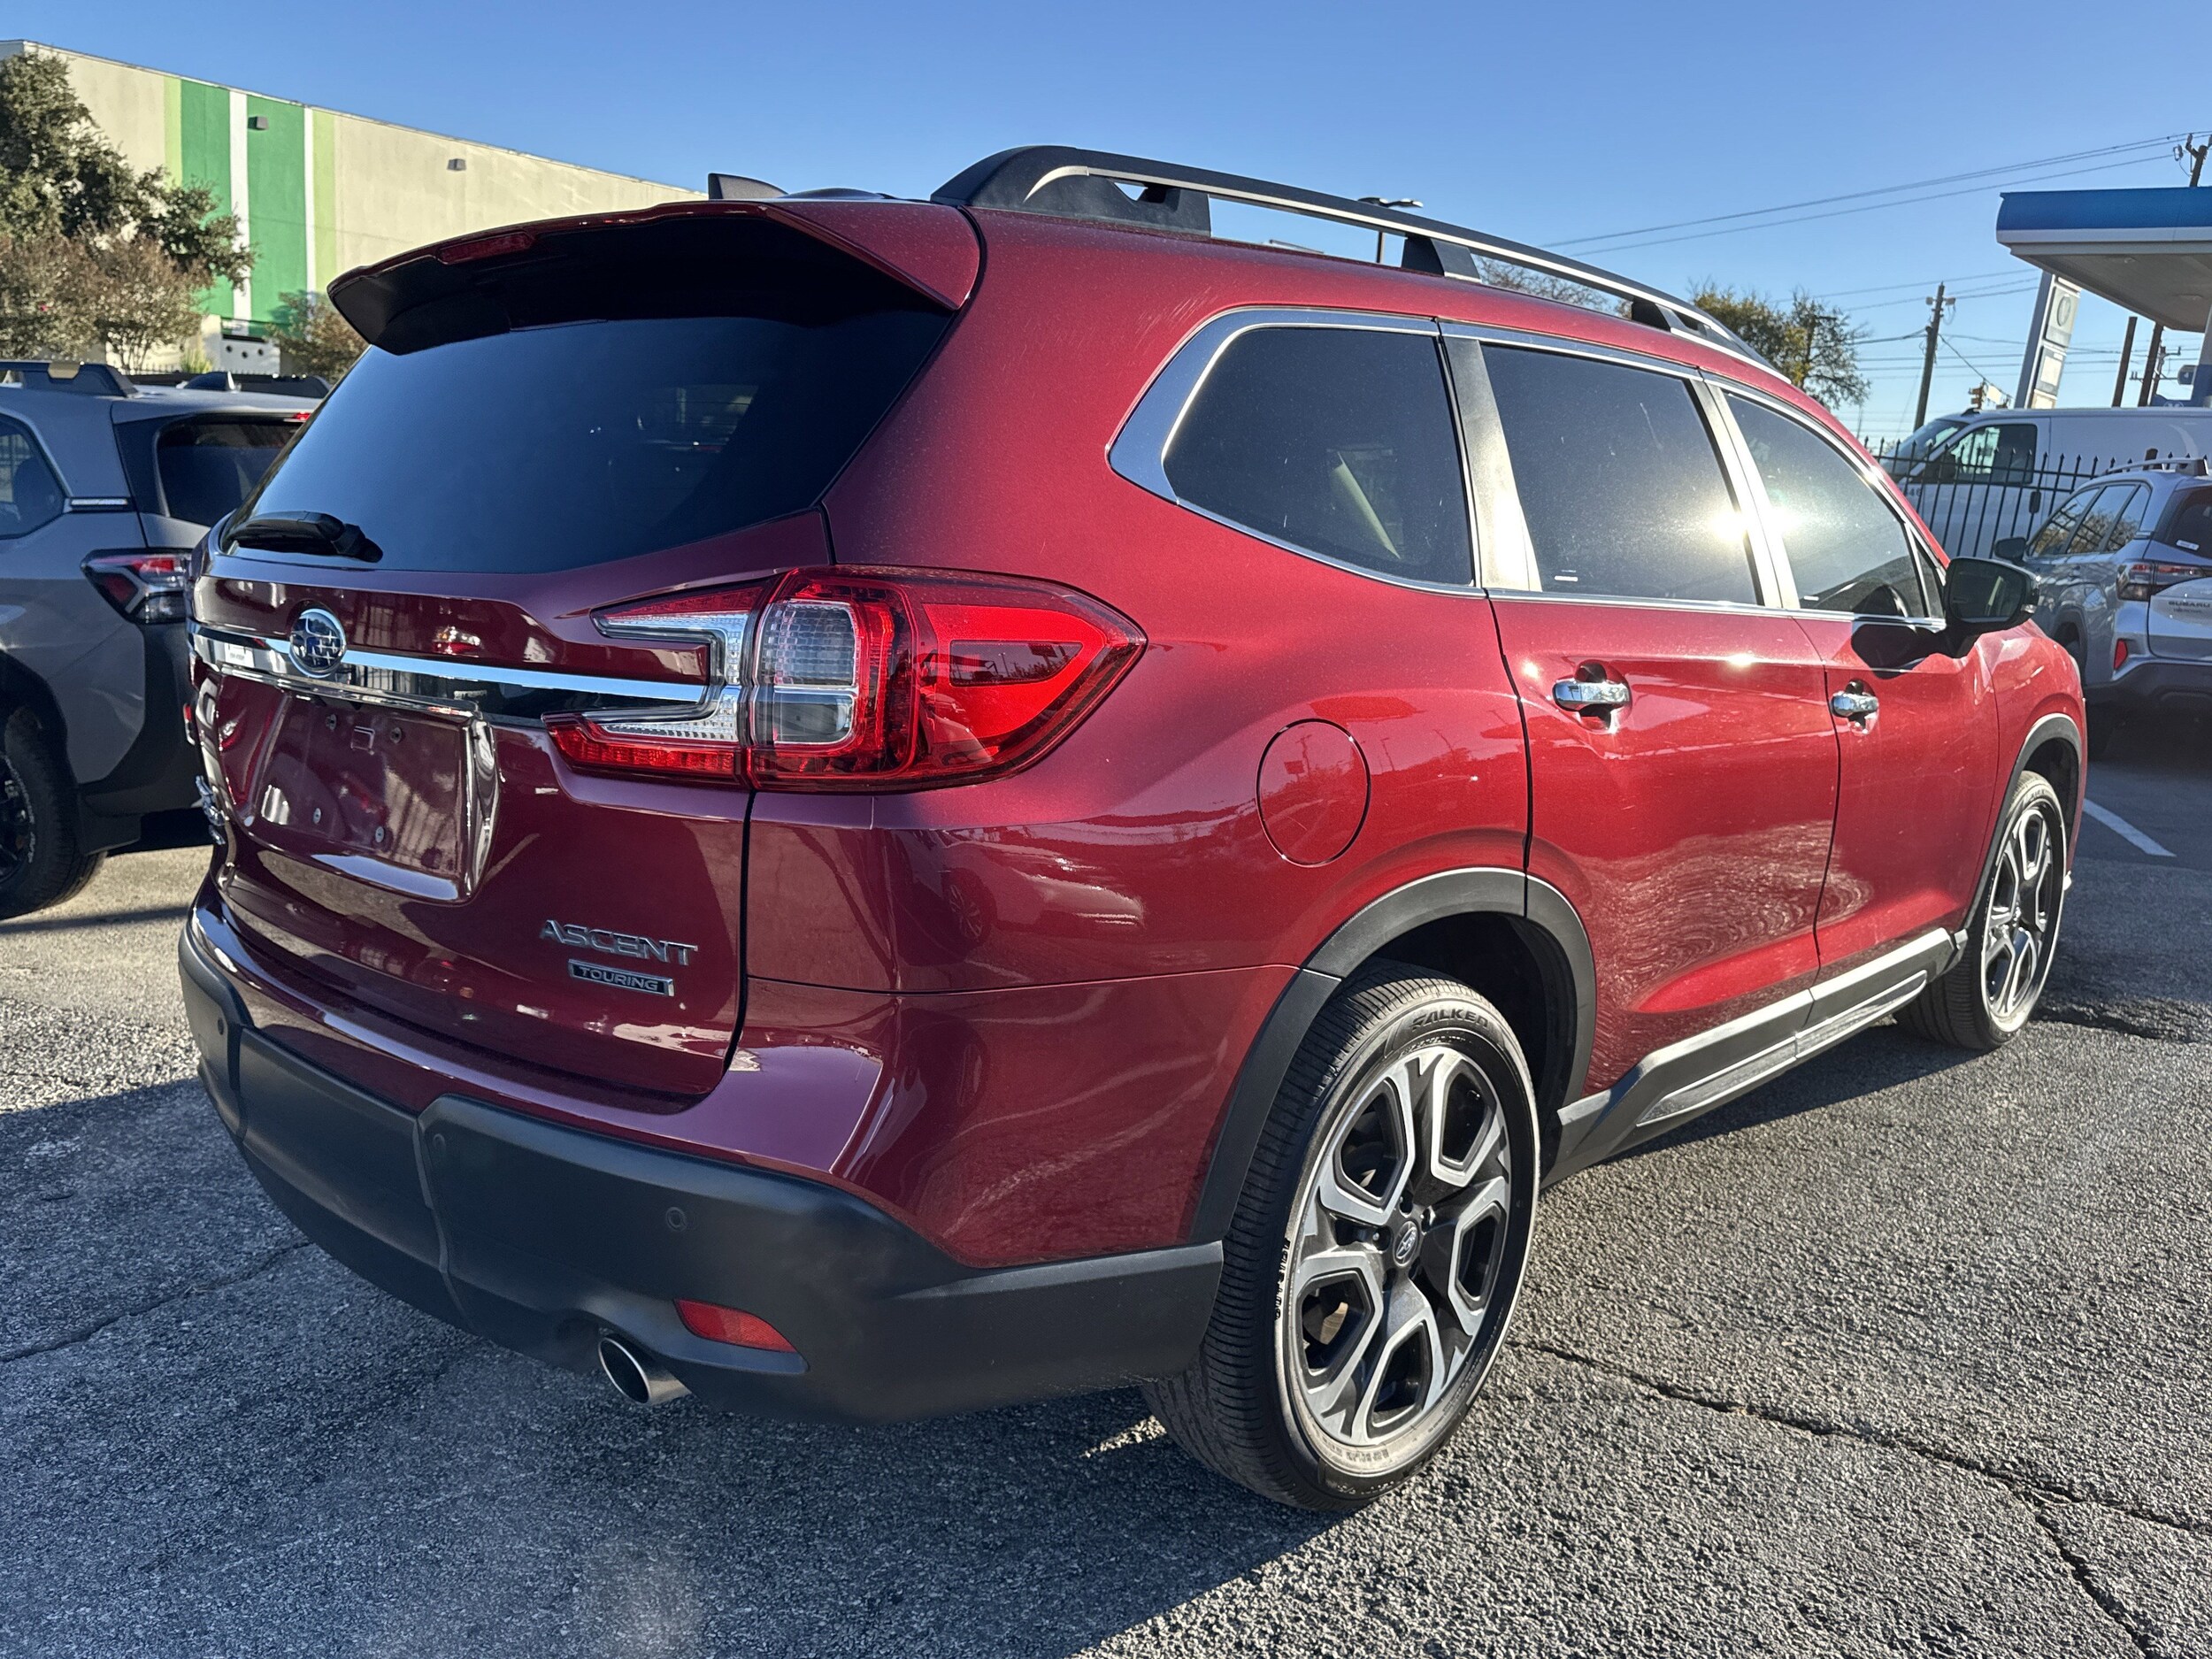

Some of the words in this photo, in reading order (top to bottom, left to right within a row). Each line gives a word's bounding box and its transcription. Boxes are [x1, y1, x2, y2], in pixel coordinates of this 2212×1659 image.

[539, 919, 698, 965] ASCENT
[580, 966, 658, 991] TOURING
[1409, 1008, 1488, 1030] FALKEN
